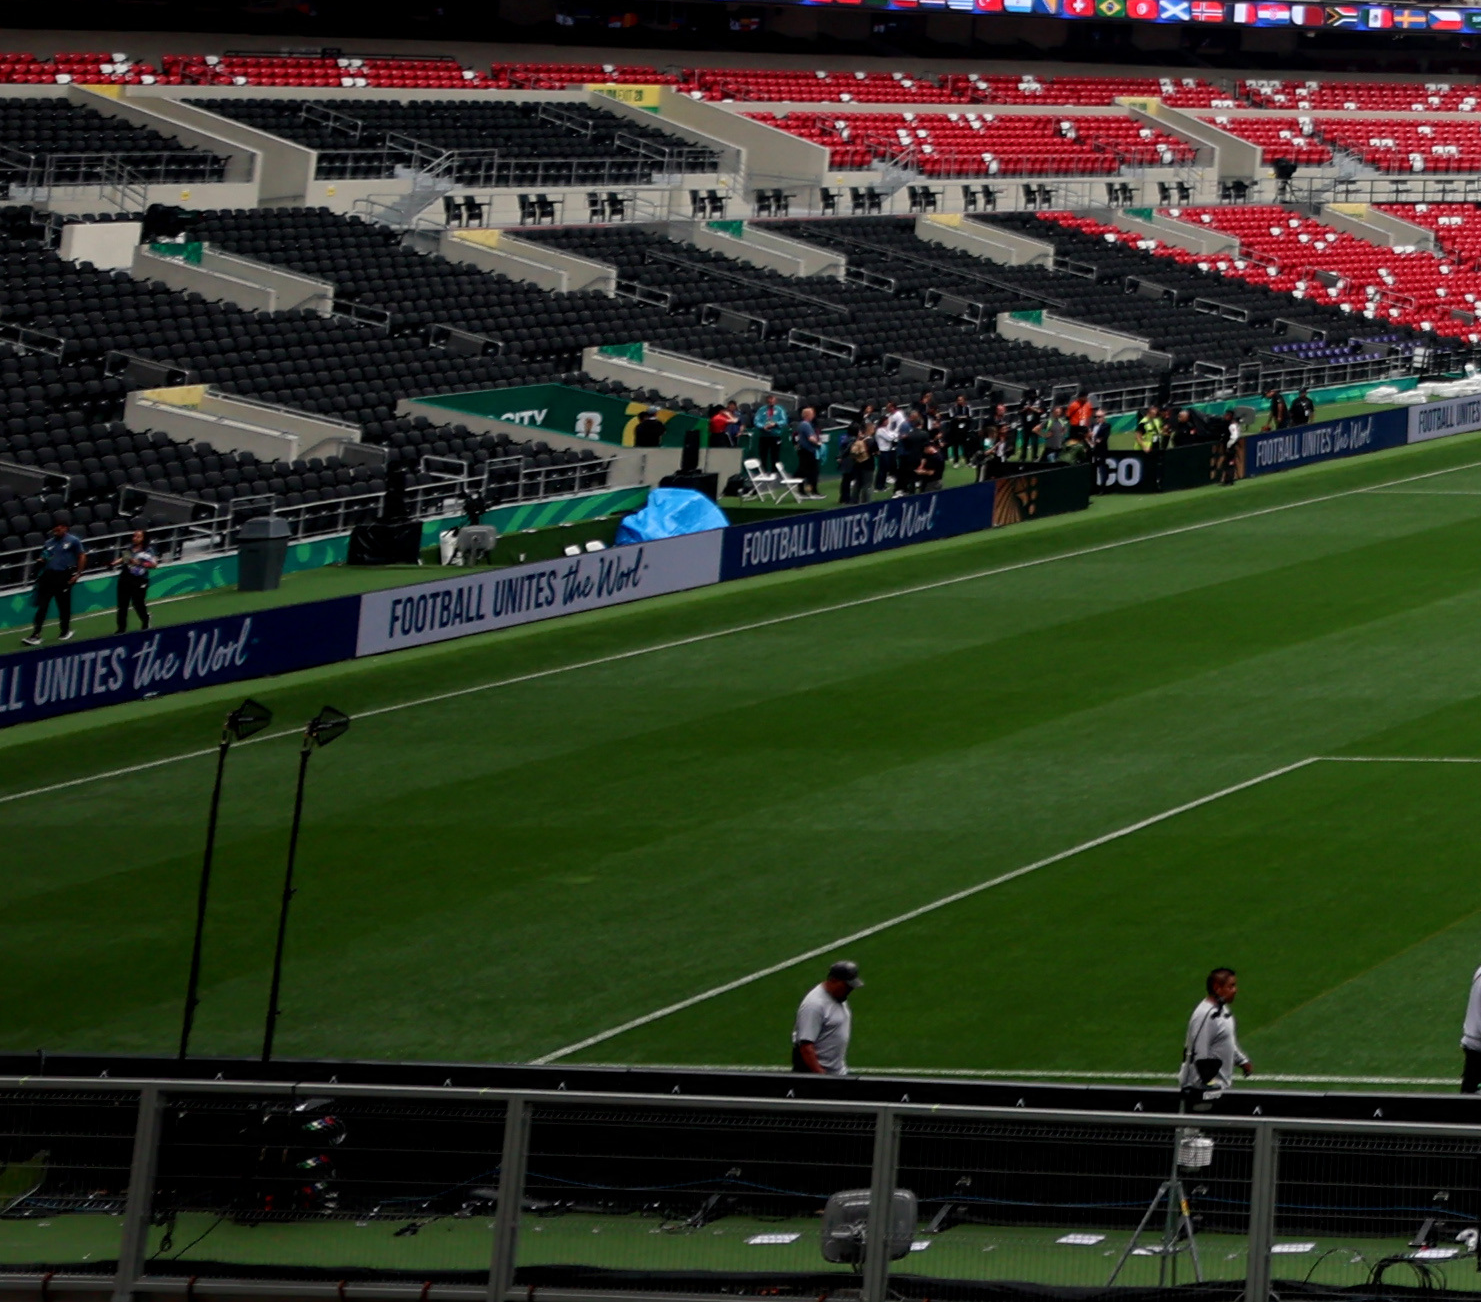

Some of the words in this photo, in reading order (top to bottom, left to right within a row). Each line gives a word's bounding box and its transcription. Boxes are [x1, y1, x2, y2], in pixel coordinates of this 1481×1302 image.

[1256, 435, 1300, 466] FOOTBALL
[1302, 428, 1331, 456] UNITES
[1333, 423, 1348, 451] the
[1418, 406, 1454, 434] FOOTBALL
[1456, 401, 1480, 425] UNITES
[742, 523, 815, 567] FOOTBALL
[820, 513, 869, 553] UNITES
[873, 507, 898, 543] the
[389, 588, 485, 637] FOOTBALL
[493, 570, 555, 618] UNITES
[561, 562, 594, 606] the
[35, 647, 122, 707] UNITES
[131, 634, 179, 690] the
